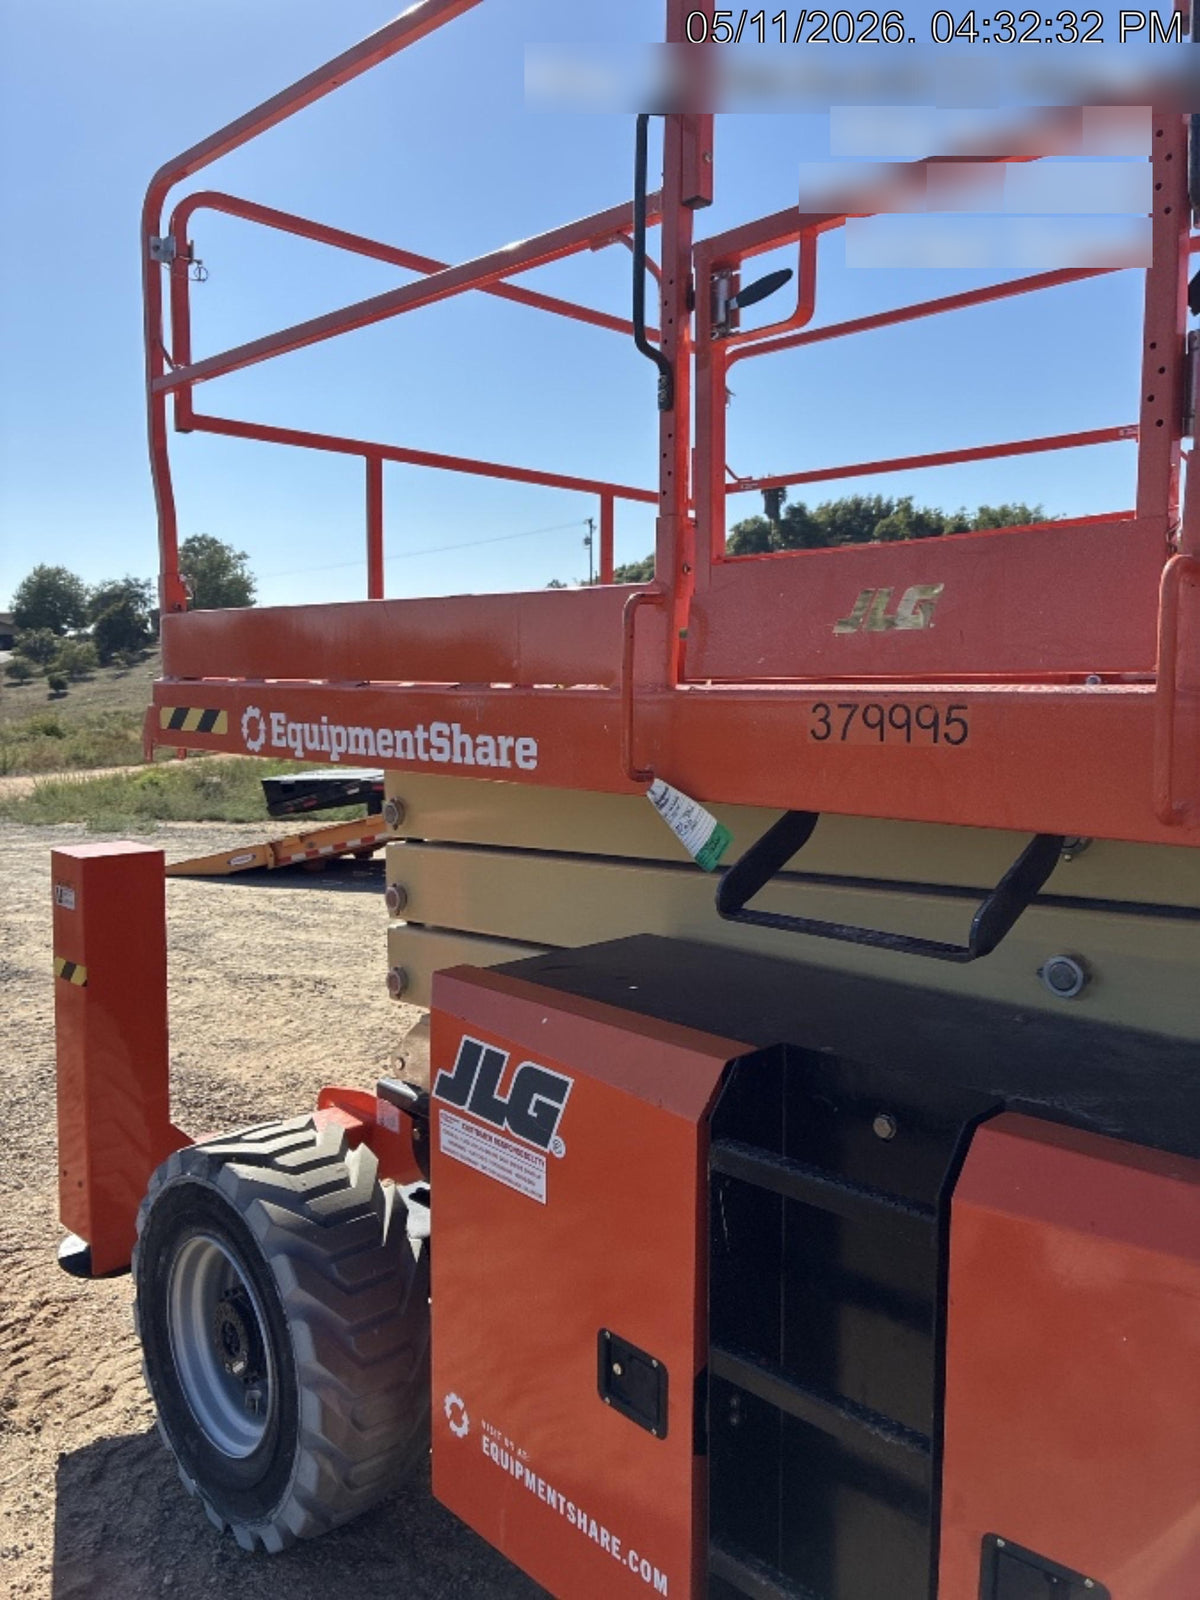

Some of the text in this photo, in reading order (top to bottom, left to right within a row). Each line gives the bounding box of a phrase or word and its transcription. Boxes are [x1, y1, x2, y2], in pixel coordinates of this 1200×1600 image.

[832, 583, 945, 634] JLG
[269, 711, 538, 770] EquipmentShare
[810, 703, 969, 746] 379995
[432, 1034, 575, 1153] JLG
[482, 1434, 668, 1597] EQUIPMENTSHARE.COM
